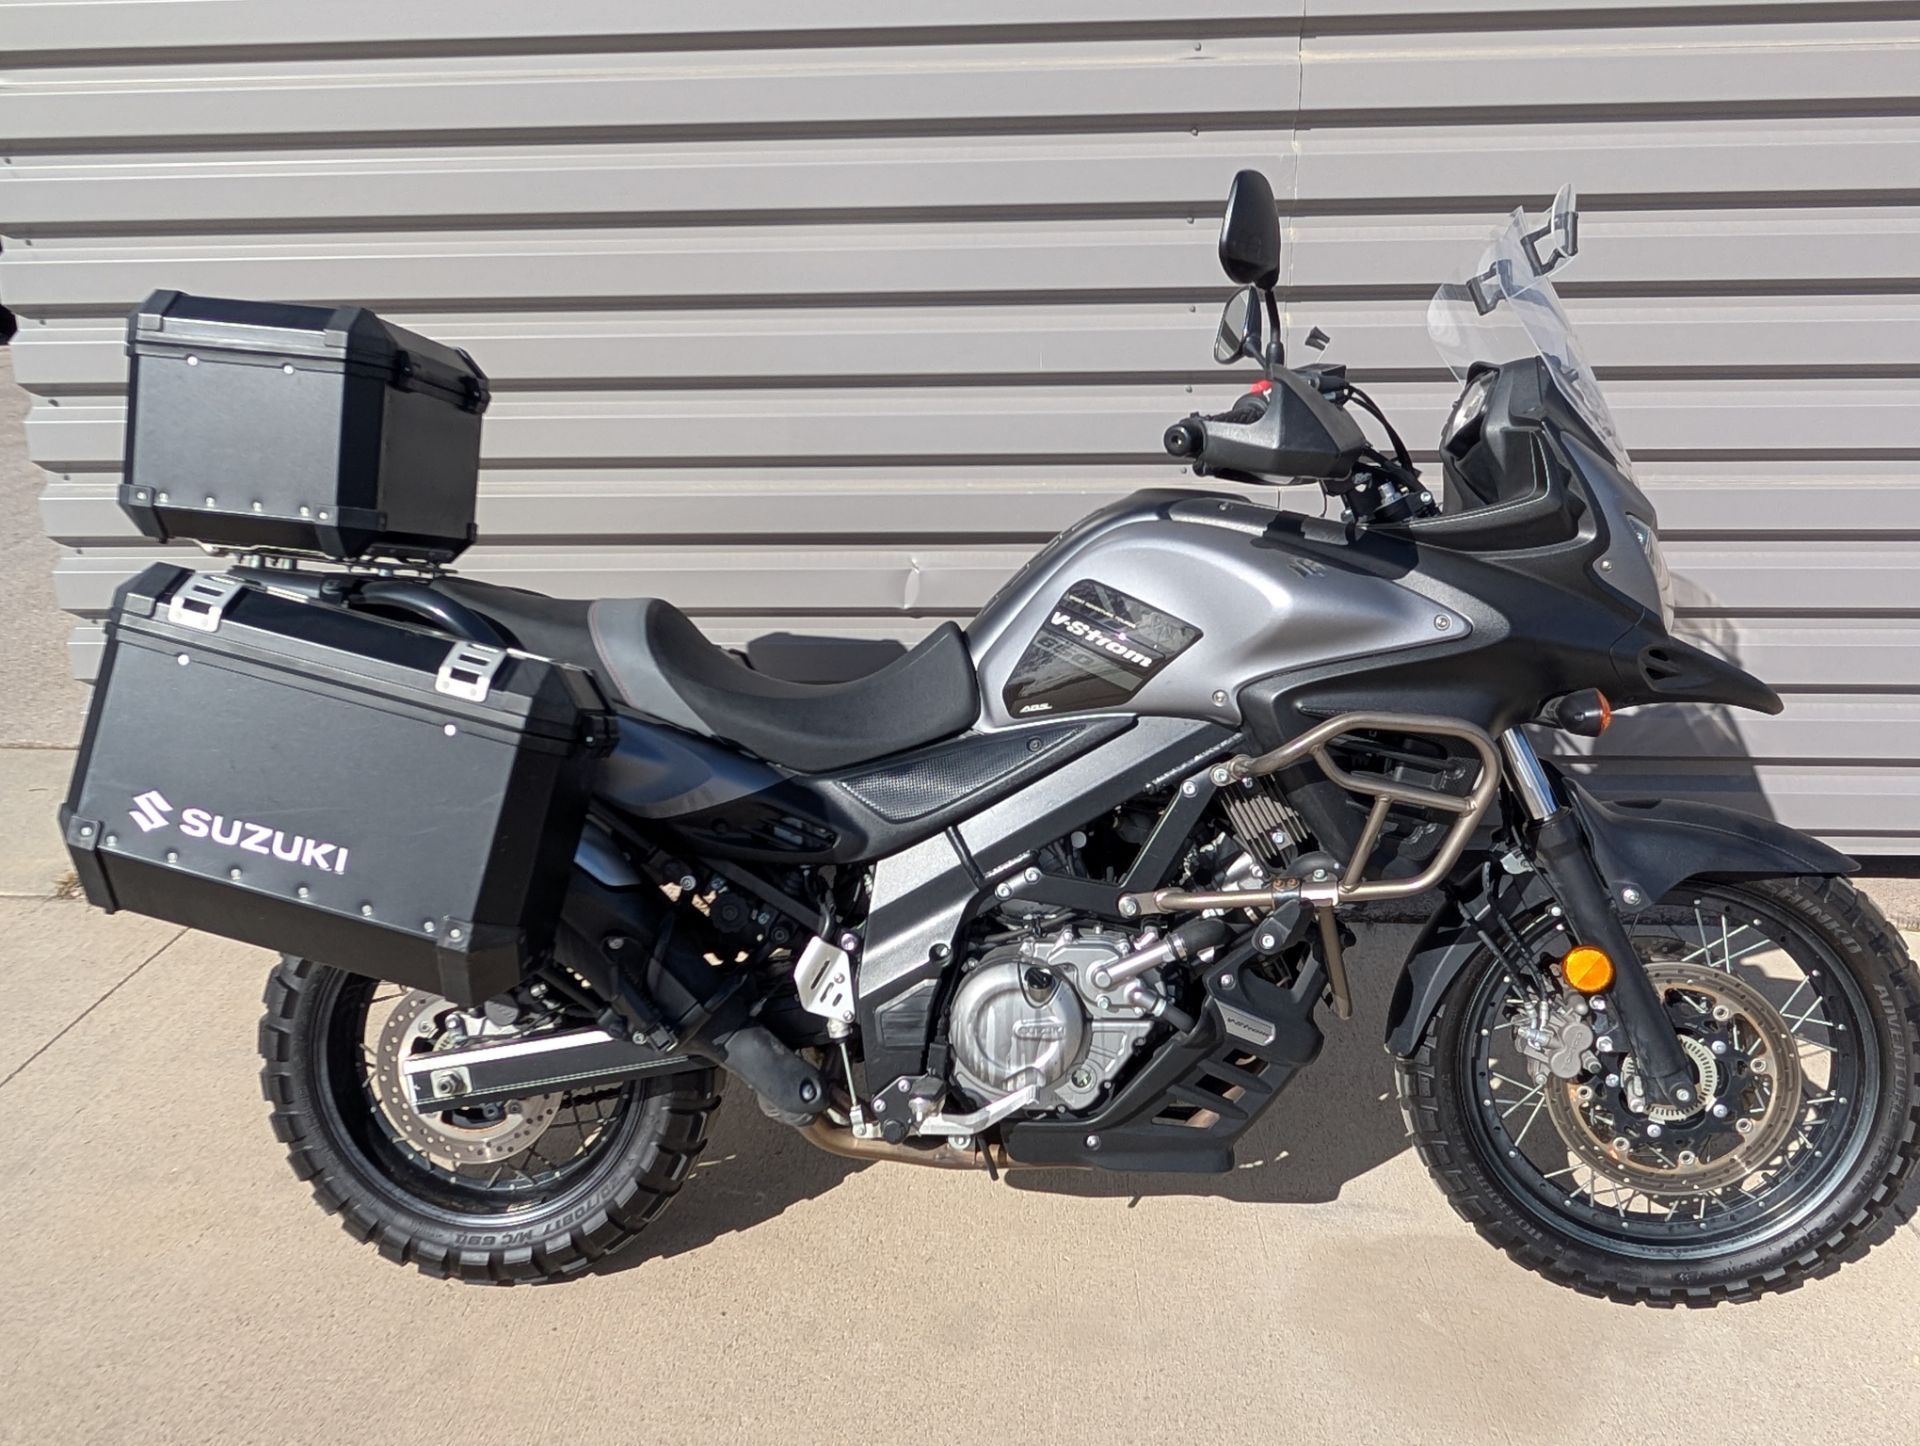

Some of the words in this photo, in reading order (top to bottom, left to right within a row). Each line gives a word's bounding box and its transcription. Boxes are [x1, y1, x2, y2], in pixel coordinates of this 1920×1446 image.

[1019, 702, 1053, 714] ABS
[179, 807, 349, 875] SUZUKI
[1871, 981, 1905, 1123] ADVENTURE
[500, 1229, 534, 1245] M/C
